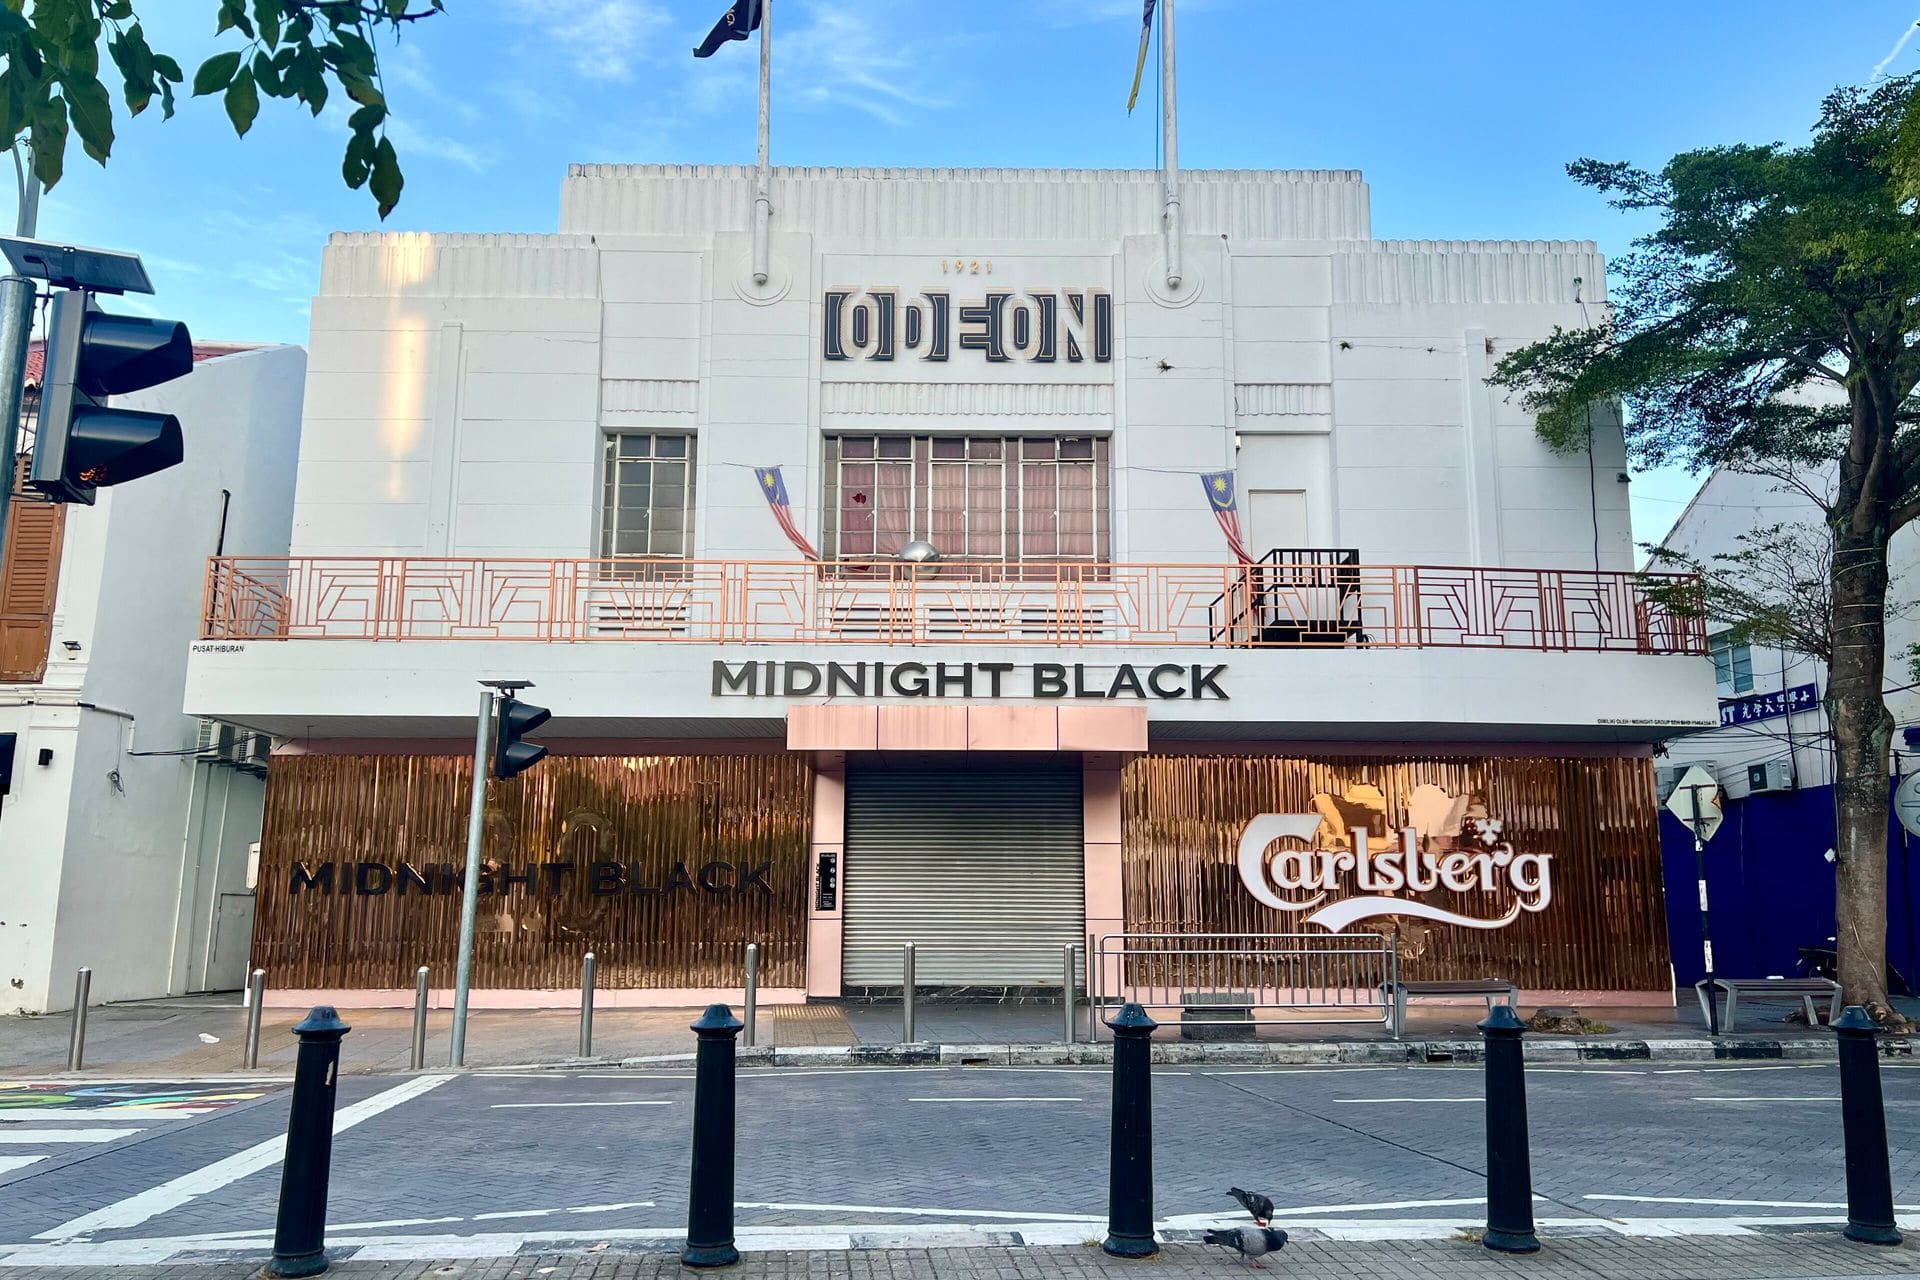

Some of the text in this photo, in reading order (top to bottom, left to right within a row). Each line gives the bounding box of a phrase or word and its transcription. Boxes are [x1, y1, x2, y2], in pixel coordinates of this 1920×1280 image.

[943, 259, 993, 275] 1921
[824, 288, 1112, 362] ODEON
[712, 660, 1230, 700] MIDNIGHT BLACK
[289, 860, 777, 896] MIDNIGHT BLACK
[1236, 812, 1554, 933] Carlsberg
